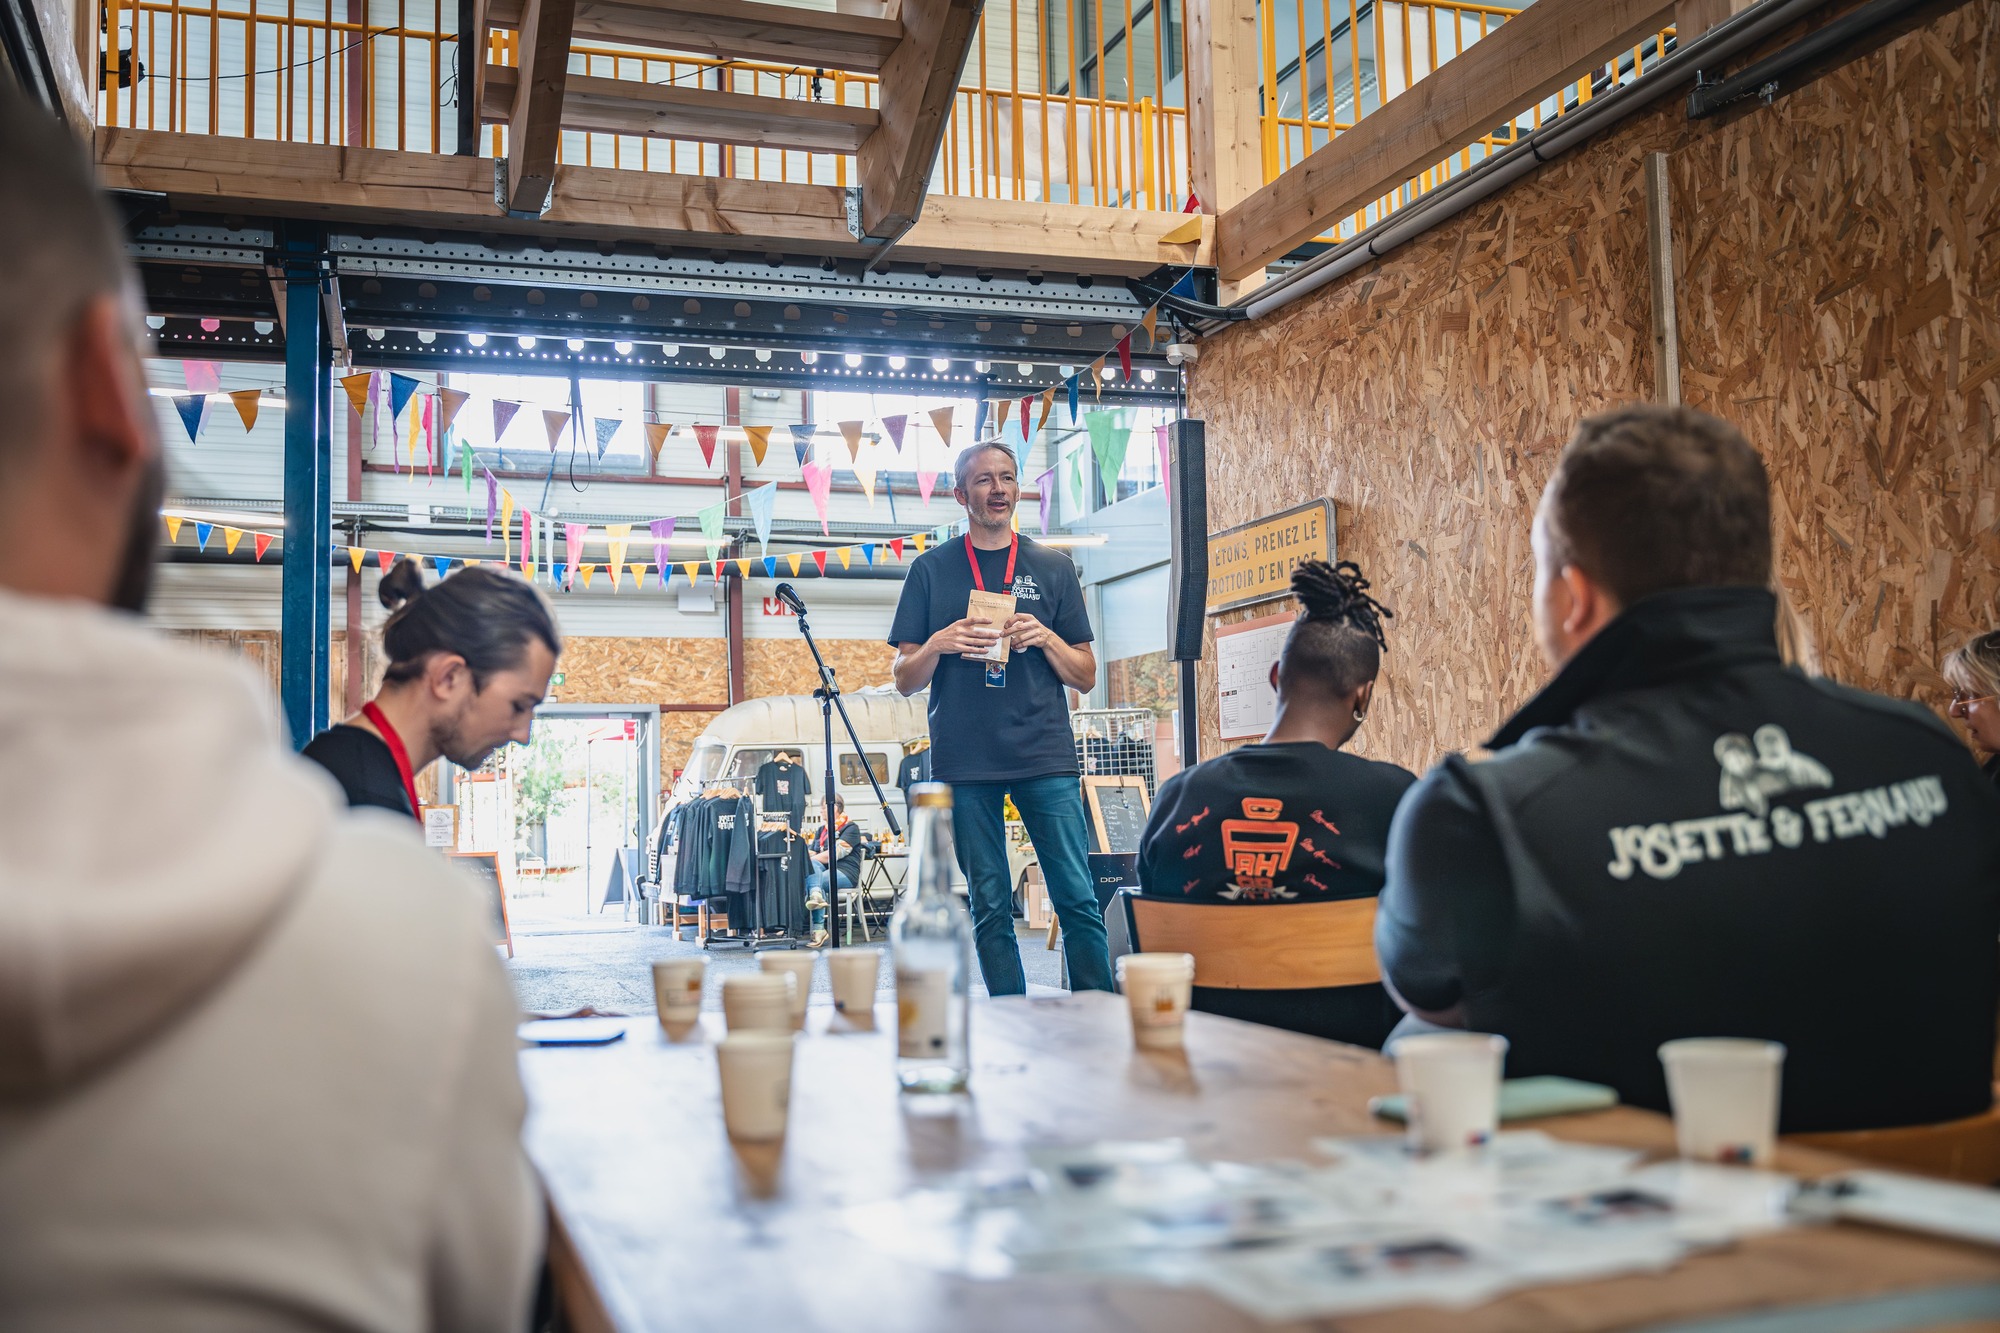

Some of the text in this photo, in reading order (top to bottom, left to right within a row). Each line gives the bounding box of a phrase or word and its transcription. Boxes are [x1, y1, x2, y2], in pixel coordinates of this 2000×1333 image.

[1255, 525, 1299, 555] PRENEZ
[1304, 520, 1317, 541] LE
[1607, 775, 1948, 880] JOSETTE & FERNAND
